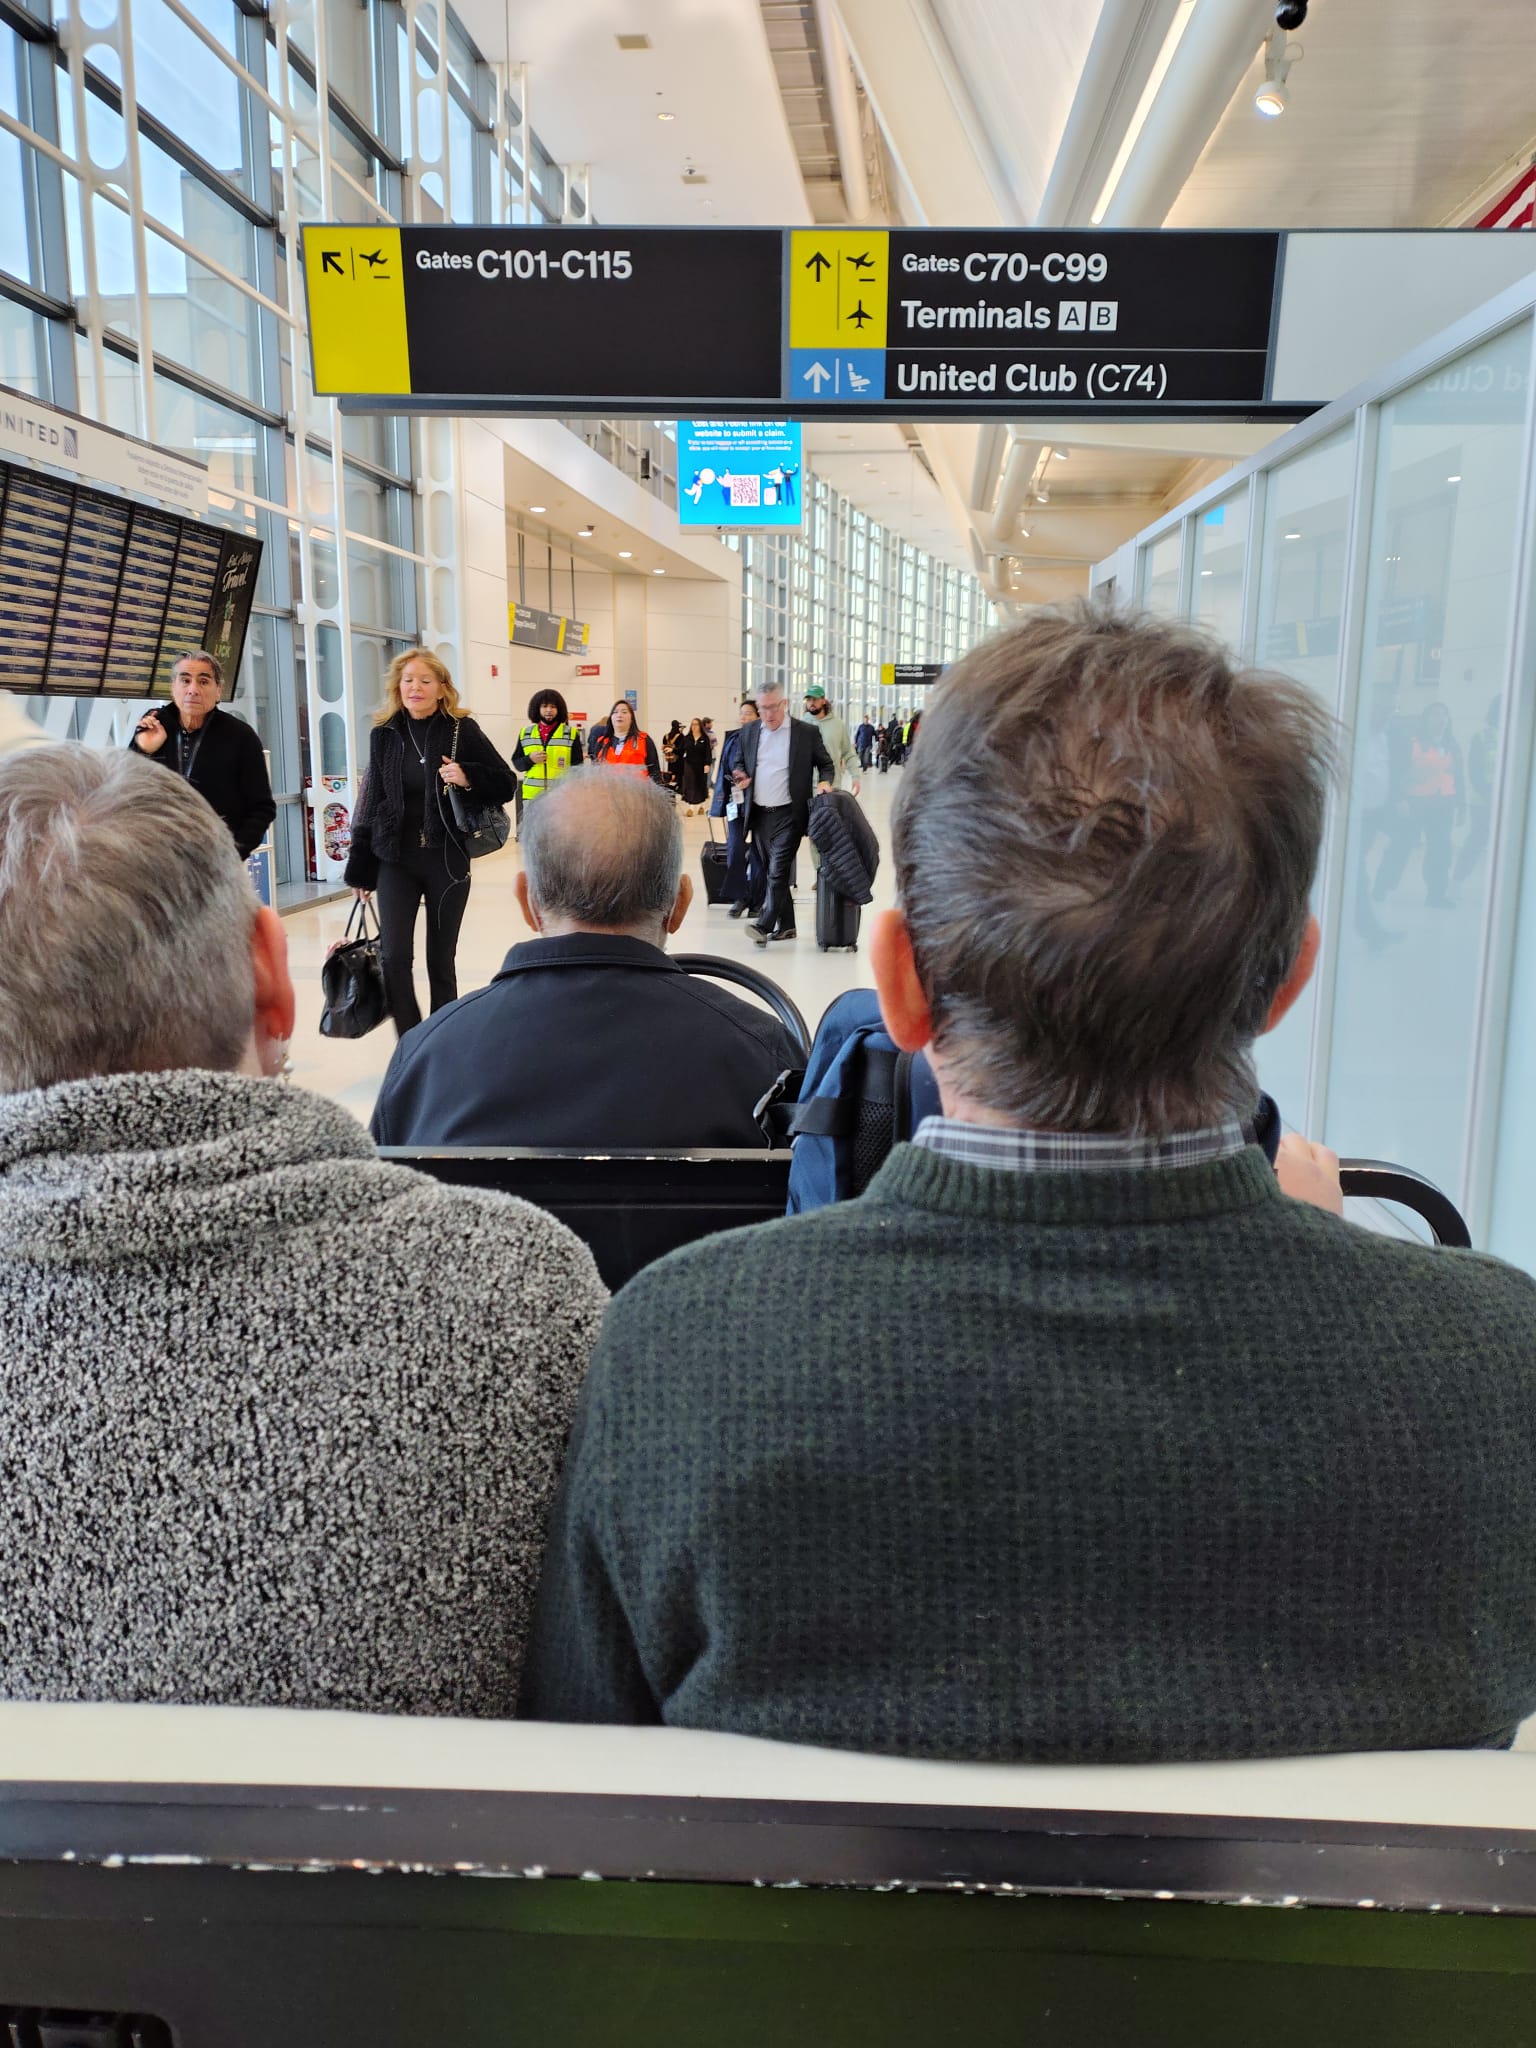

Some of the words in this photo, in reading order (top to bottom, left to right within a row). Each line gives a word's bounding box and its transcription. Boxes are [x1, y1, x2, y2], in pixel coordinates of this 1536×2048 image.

[416, 250, 473, 270] Gates
[476, 249, 633, 280] C101-C115
[902, 253, 961, 273] Gates
[963, 252, 1109, 283] C70-C99
[901, 300, 1051, 329] Terminals
[1064, 306, 1080, 326] A
[1096, 306, 1111, 326] B
[898, 363, 997, 392] United
[1005, 363, 1077, 392] Club
[1086, 363, 1168, 399] (C74)
[0, 410, 59, 446] NITED
